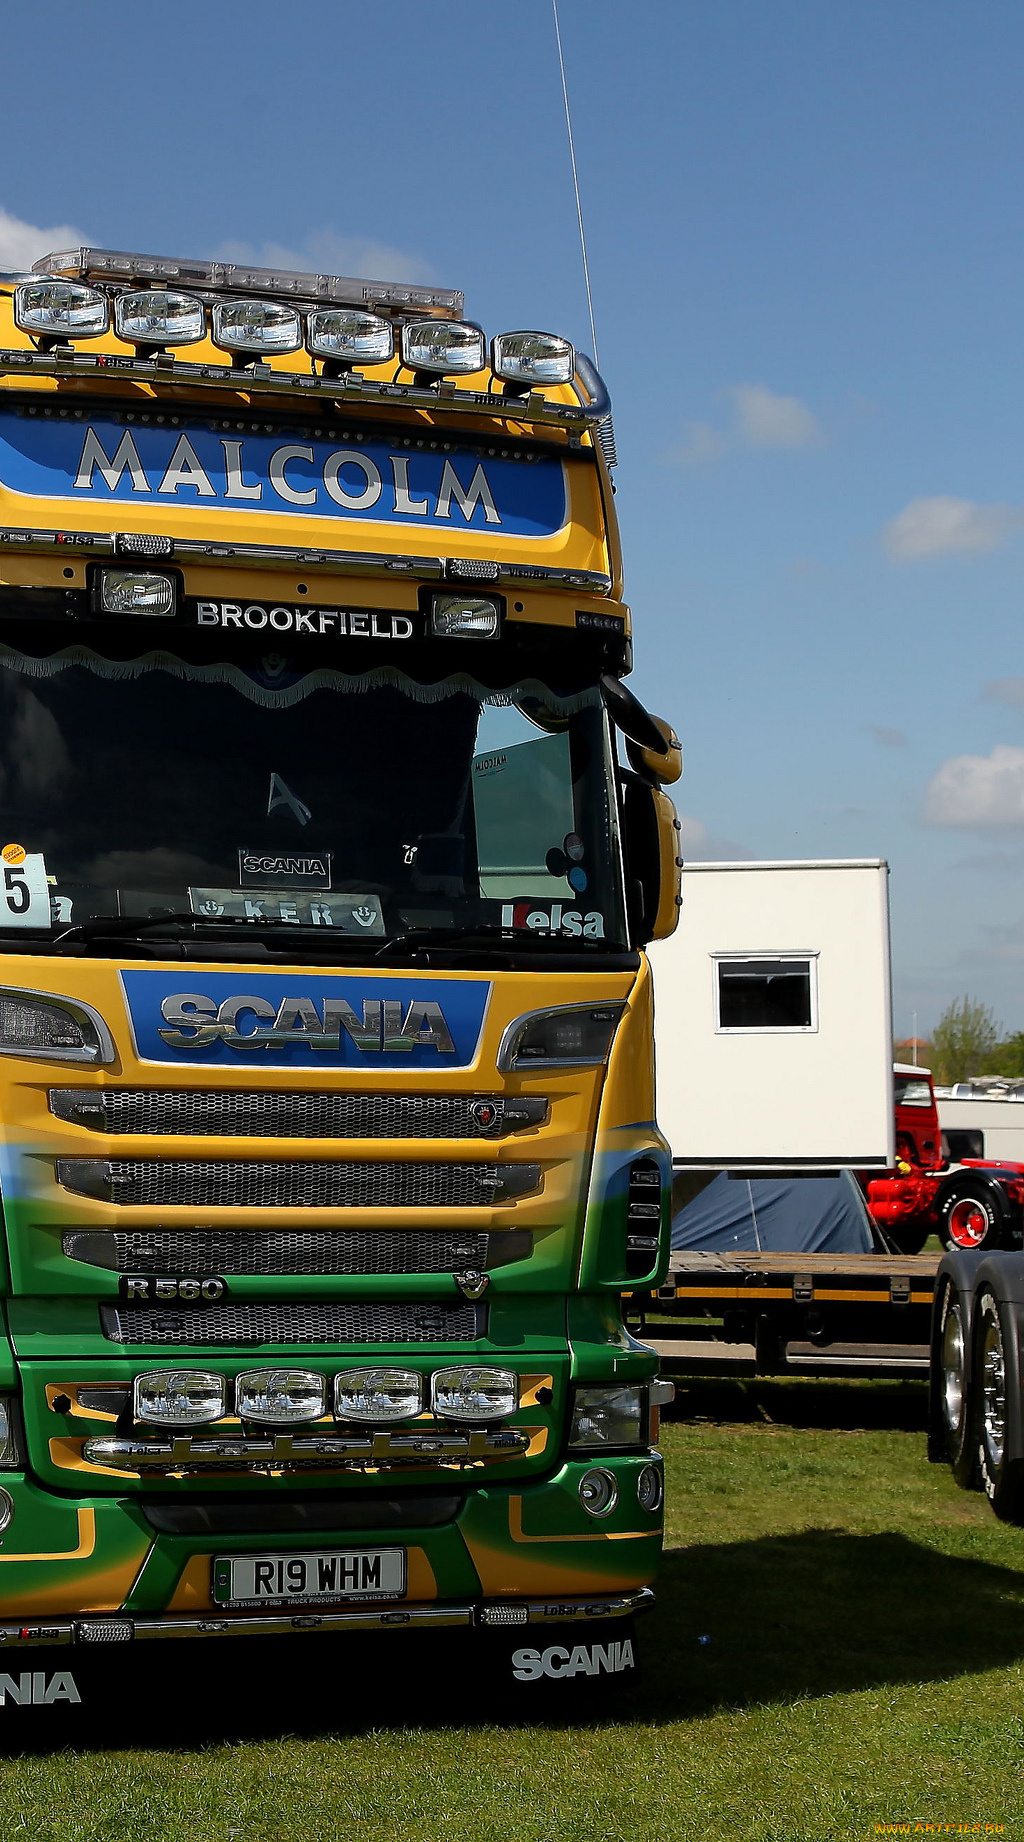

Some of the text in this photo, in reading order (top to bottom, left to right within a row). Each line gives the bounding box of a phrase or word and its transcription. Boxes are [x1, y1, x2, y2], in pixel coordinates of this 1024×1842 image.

[96, 356, 134, 368] Kelsa
[73, 426, 503, 524] MALCOLM
[53, 533, 95, 546] Kelsa
[196, 602, 413, 639] BROOKFIELD
[243, 856, 326, 876] SCANIA
[157, 993, 456, 1052] SCANIA
[127, 1278, 224, 1299] R 560
[254, 1555, 381, 1595] R19 WHM
[512, 1639, 635, 1681] SCANIA
